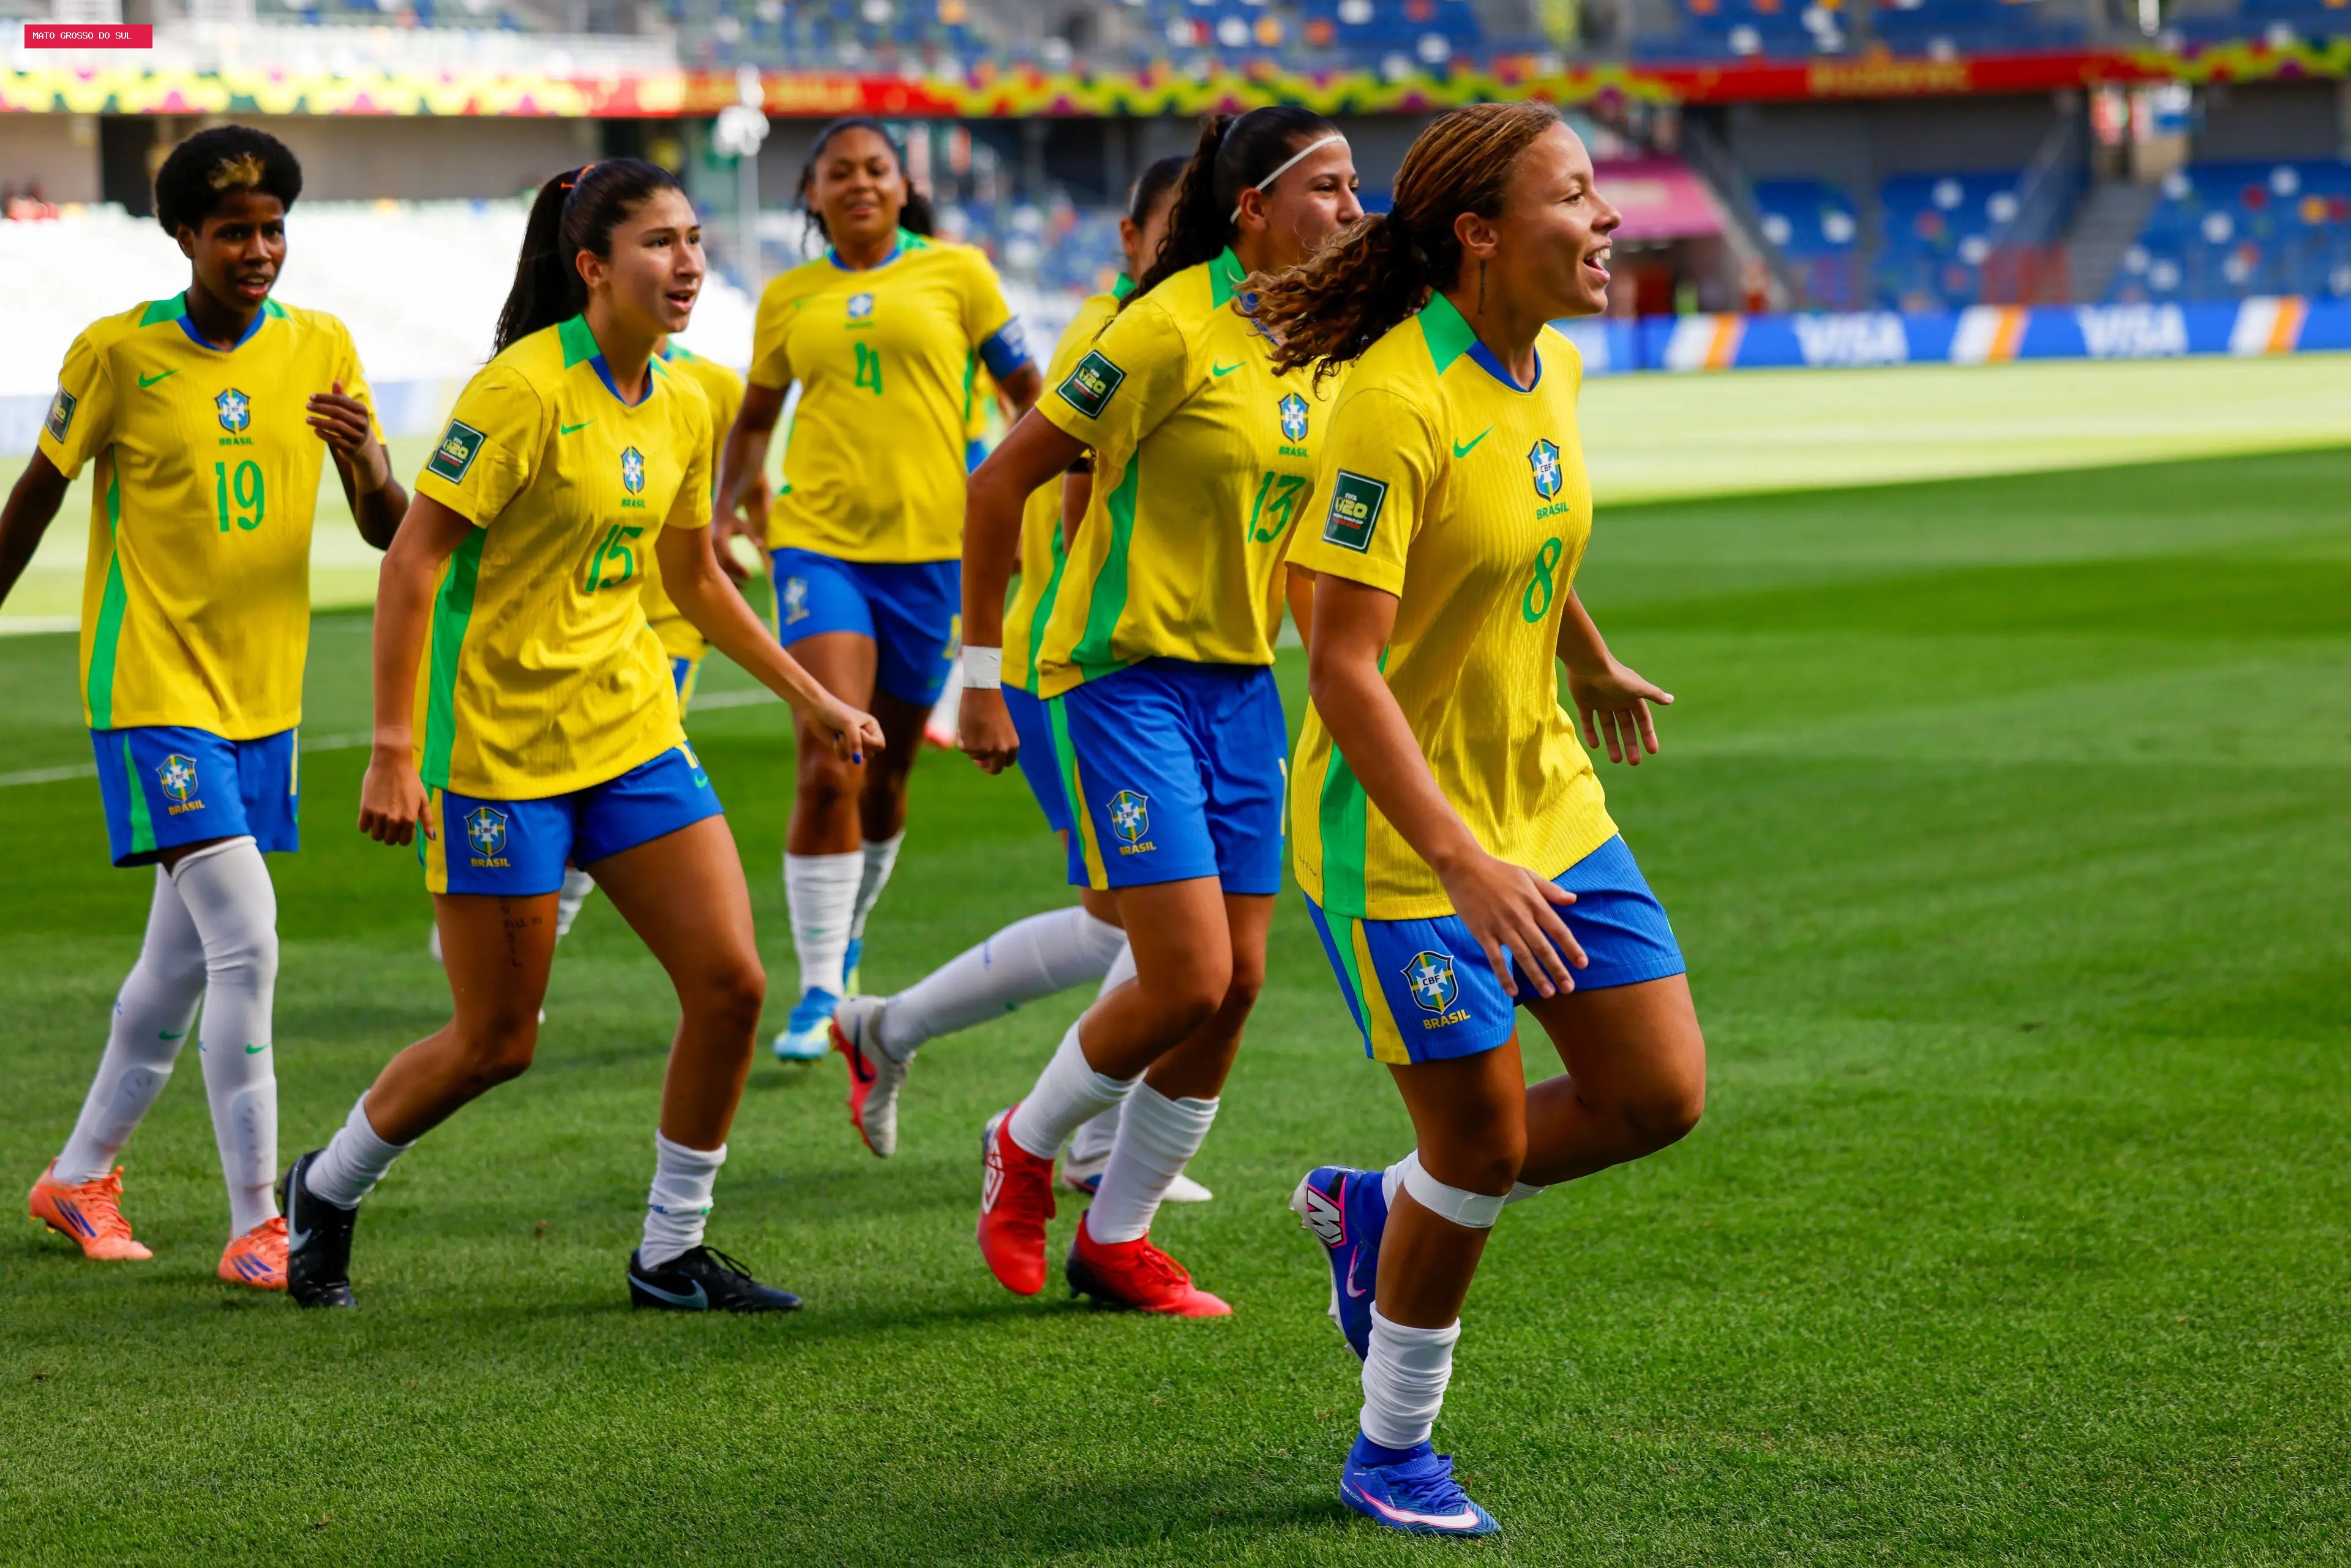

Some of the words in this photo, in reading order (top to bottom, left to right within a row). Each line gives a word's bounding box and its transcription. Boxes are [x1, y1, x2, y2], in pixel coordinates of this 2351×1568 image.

[2077, 303, 2188, 358] VISA
[855, 342, 882, 394] 4
[219, 437, 254, 446] BRASIL
[1278, 446, 1308, 457] BRASIL
[1540, 463, 1553, 473] CBF
[216, 460, 264, 532] 19
[621, 498, 645, 508] BRASIL
[1345, 492, 1357, 501] FIFA
[1248, 471, 1306, 544] 13
[1536, 501, 1570, 520] BRASIL
[585, 524, 644, 592] 15
[1523, 537, 1562, 624] 8
[168, 799, 206, 816] BRASIL
[1122, 811, 1136, 819] CBF
[1119, 841, 1157, 855] BRASIL
[471, 858, 511, 868] BRASIL
[1422, 975, 1440, 986] CBF
[1422, 1009, 1471, 1029] BRASIL
